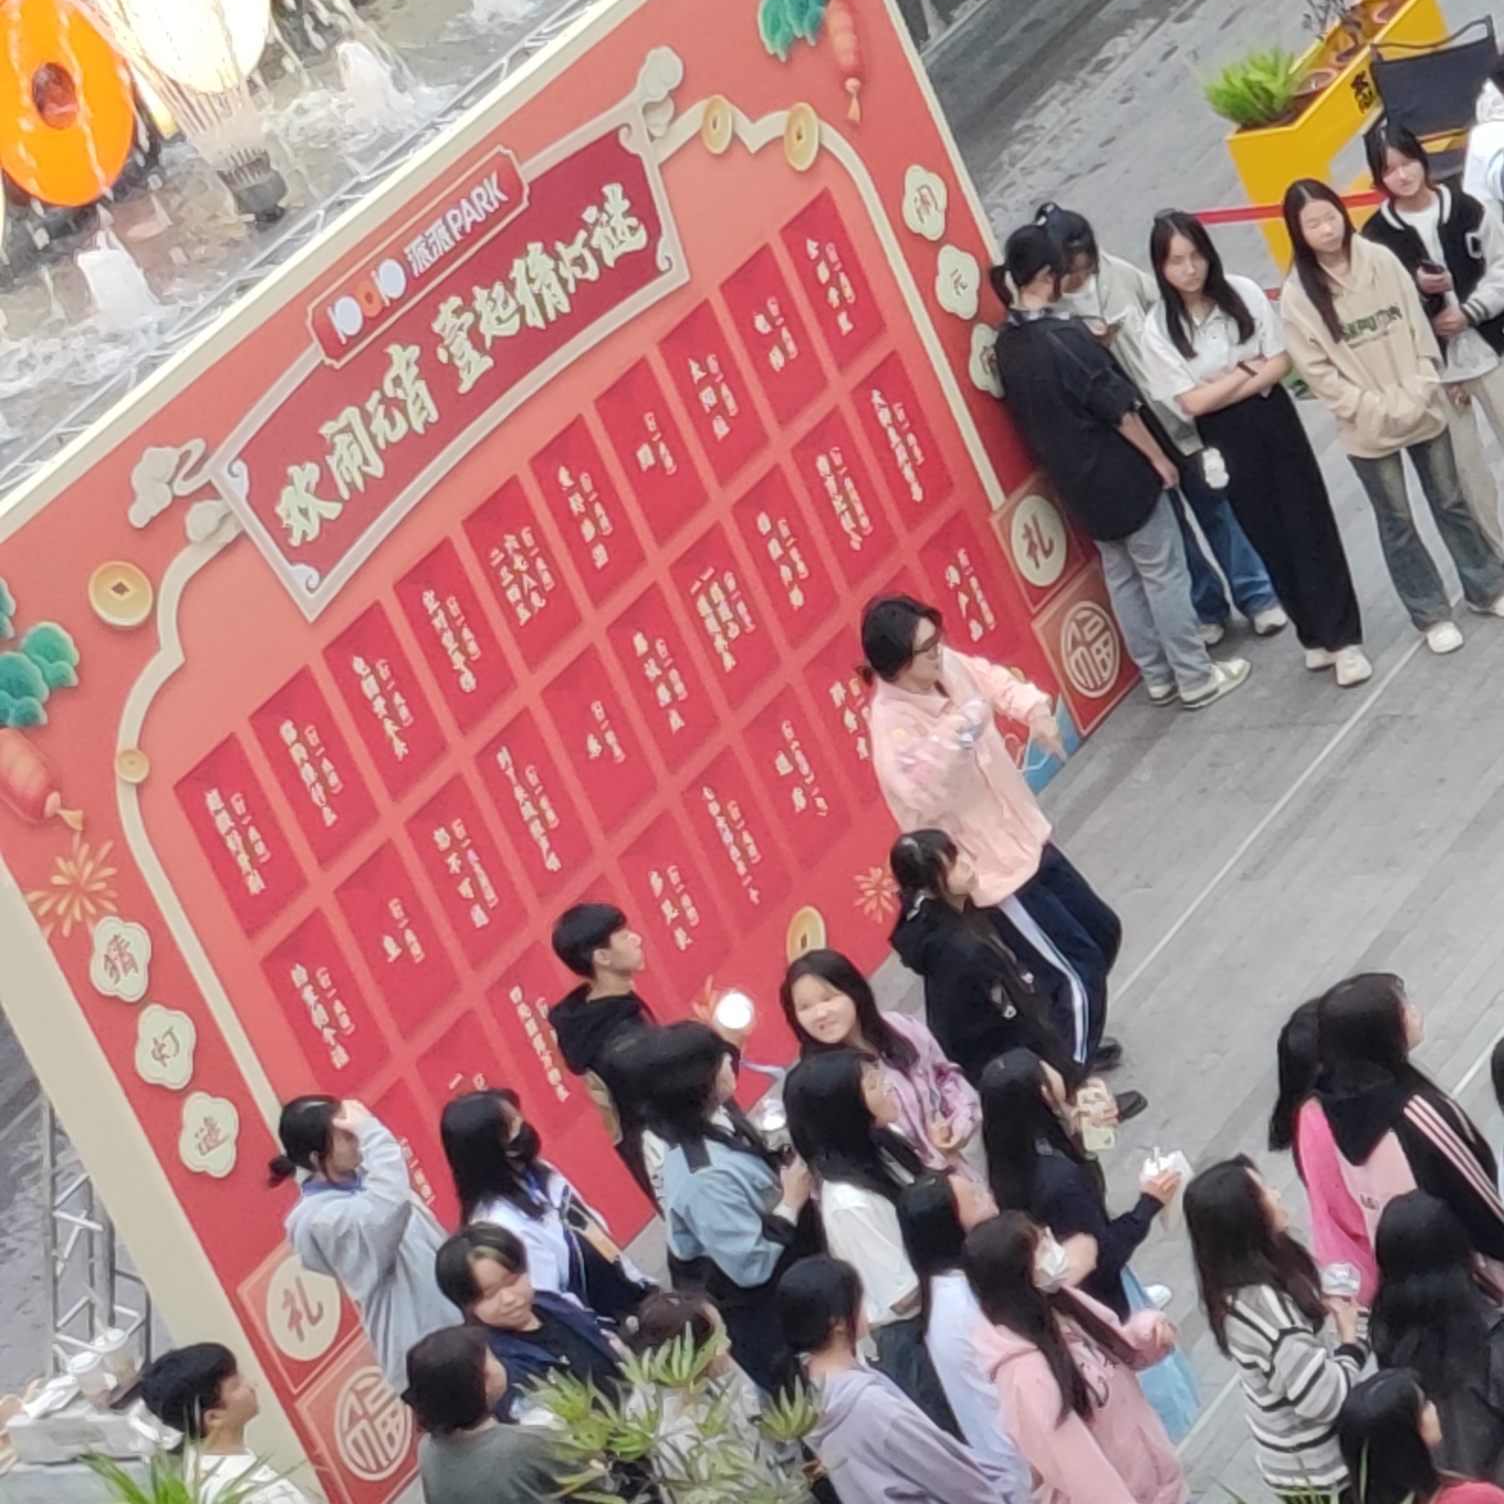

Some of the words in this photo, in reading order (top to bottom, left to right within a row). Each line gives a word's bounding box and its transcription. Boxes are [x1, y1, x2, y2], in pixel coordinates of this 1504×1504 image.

[273, 342, 440, 547] 欢闹元宵
[432, 181, 650, 395] 壹起猜灯谜
[1021, 512, 1055, 572] 礼
[1060, 600, 1119, 698] 福
[280, 1274, 325, 1342] 礼
[335, 1366, 412, 1481] 福
